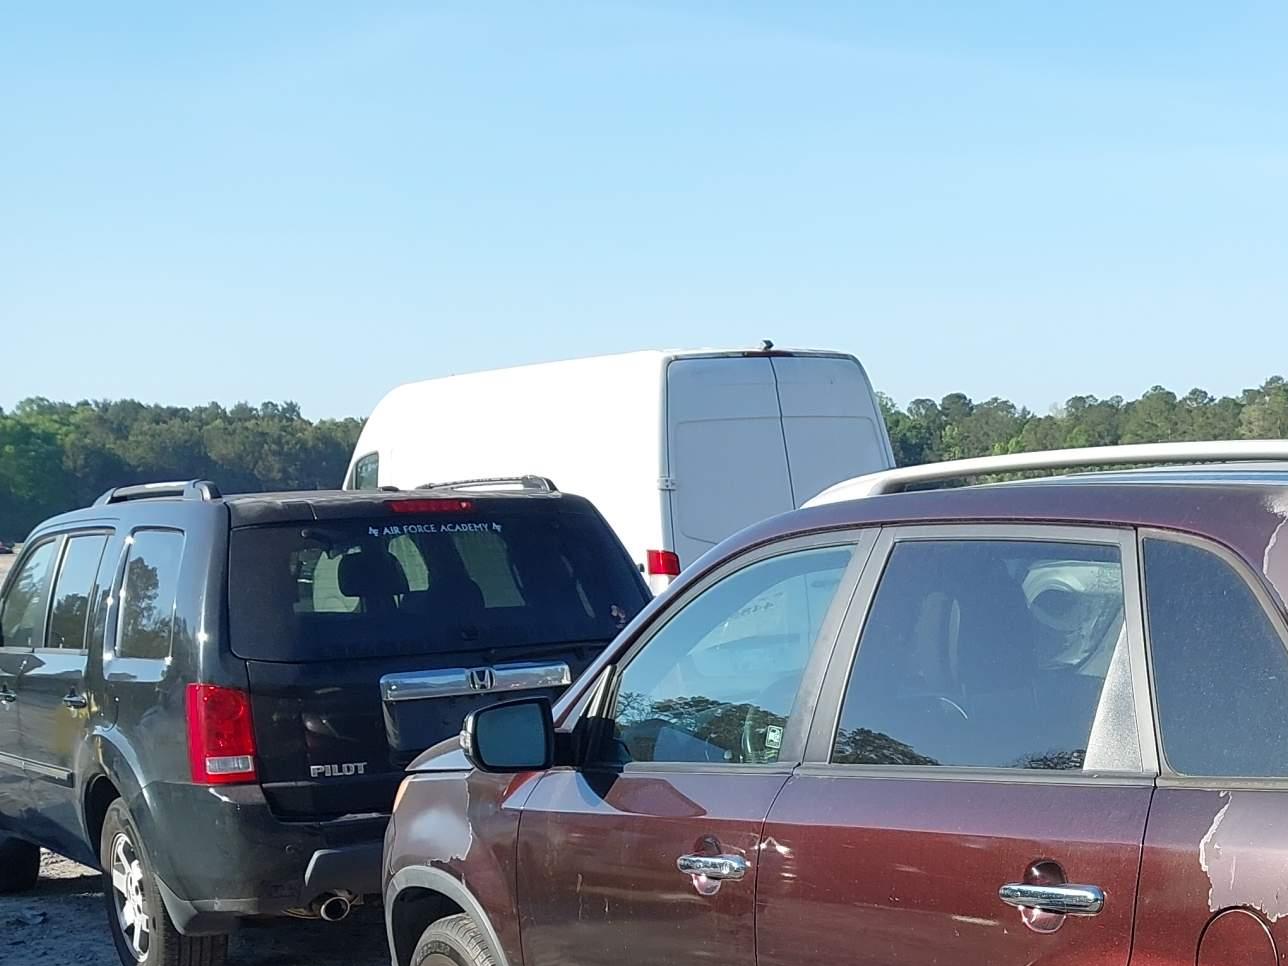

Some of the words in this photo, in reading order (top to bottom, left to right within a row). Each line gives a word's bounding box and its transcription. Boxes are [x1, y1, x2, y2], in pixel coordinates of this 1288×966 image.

[383, 526, 401, 535] AIR
[402, 524, 437, 534] FORCE
[440, 523, 489, 533] ACADEMY
[310, 762, 367, 777] PILOT
